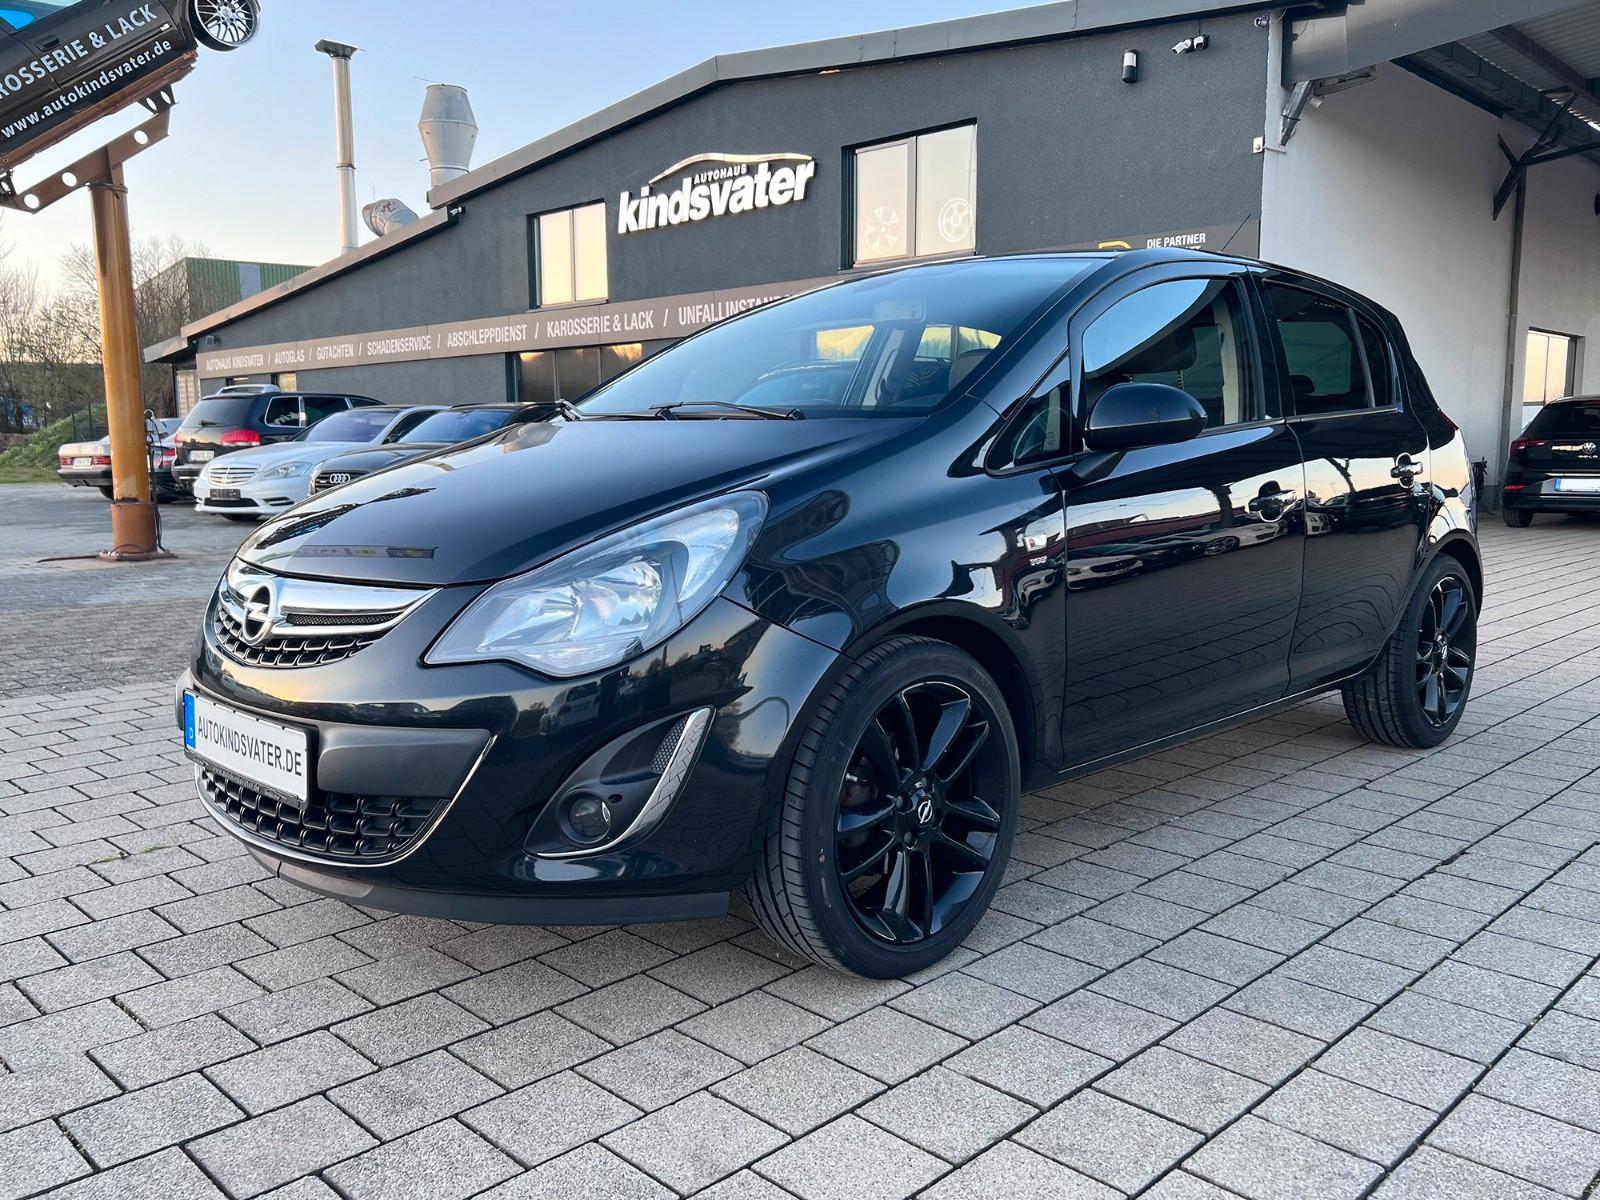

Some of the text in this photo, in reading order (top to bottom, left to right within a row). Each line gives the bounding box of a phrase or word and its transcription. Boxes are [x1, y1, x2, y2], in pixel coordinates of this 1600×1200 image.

[88, 31, 107, 48] &
[105, 4, 157, 40] LACK
[1, 39, 171, 139] www.autokindsvater.de
[618, 161, 815, 234] kindsvater
[694, 163, 747, 185] AUTOHAUS
[1147, 233, 1206, 249] DIE PARTNER
[206, 357, 231, 371] AUTOHAUS
[233, 354, 263, 369] KINDSVATER
[274, 349, 304, 365] AUTOGLAS
[317, 344, 353, 360] GUTACHTEN
[367, 335, 431, 356] SCHADENSERVICE
[447, 324, 527, 347] ABSCHLEPPDIENST
[547, 315, 610, 338] KAROSSERIE
[613, 314, 621, 331] &
[624, 310, 654, 329] LACK
[198, 716, 302, 776] AUTOKINDSVATER.DE
